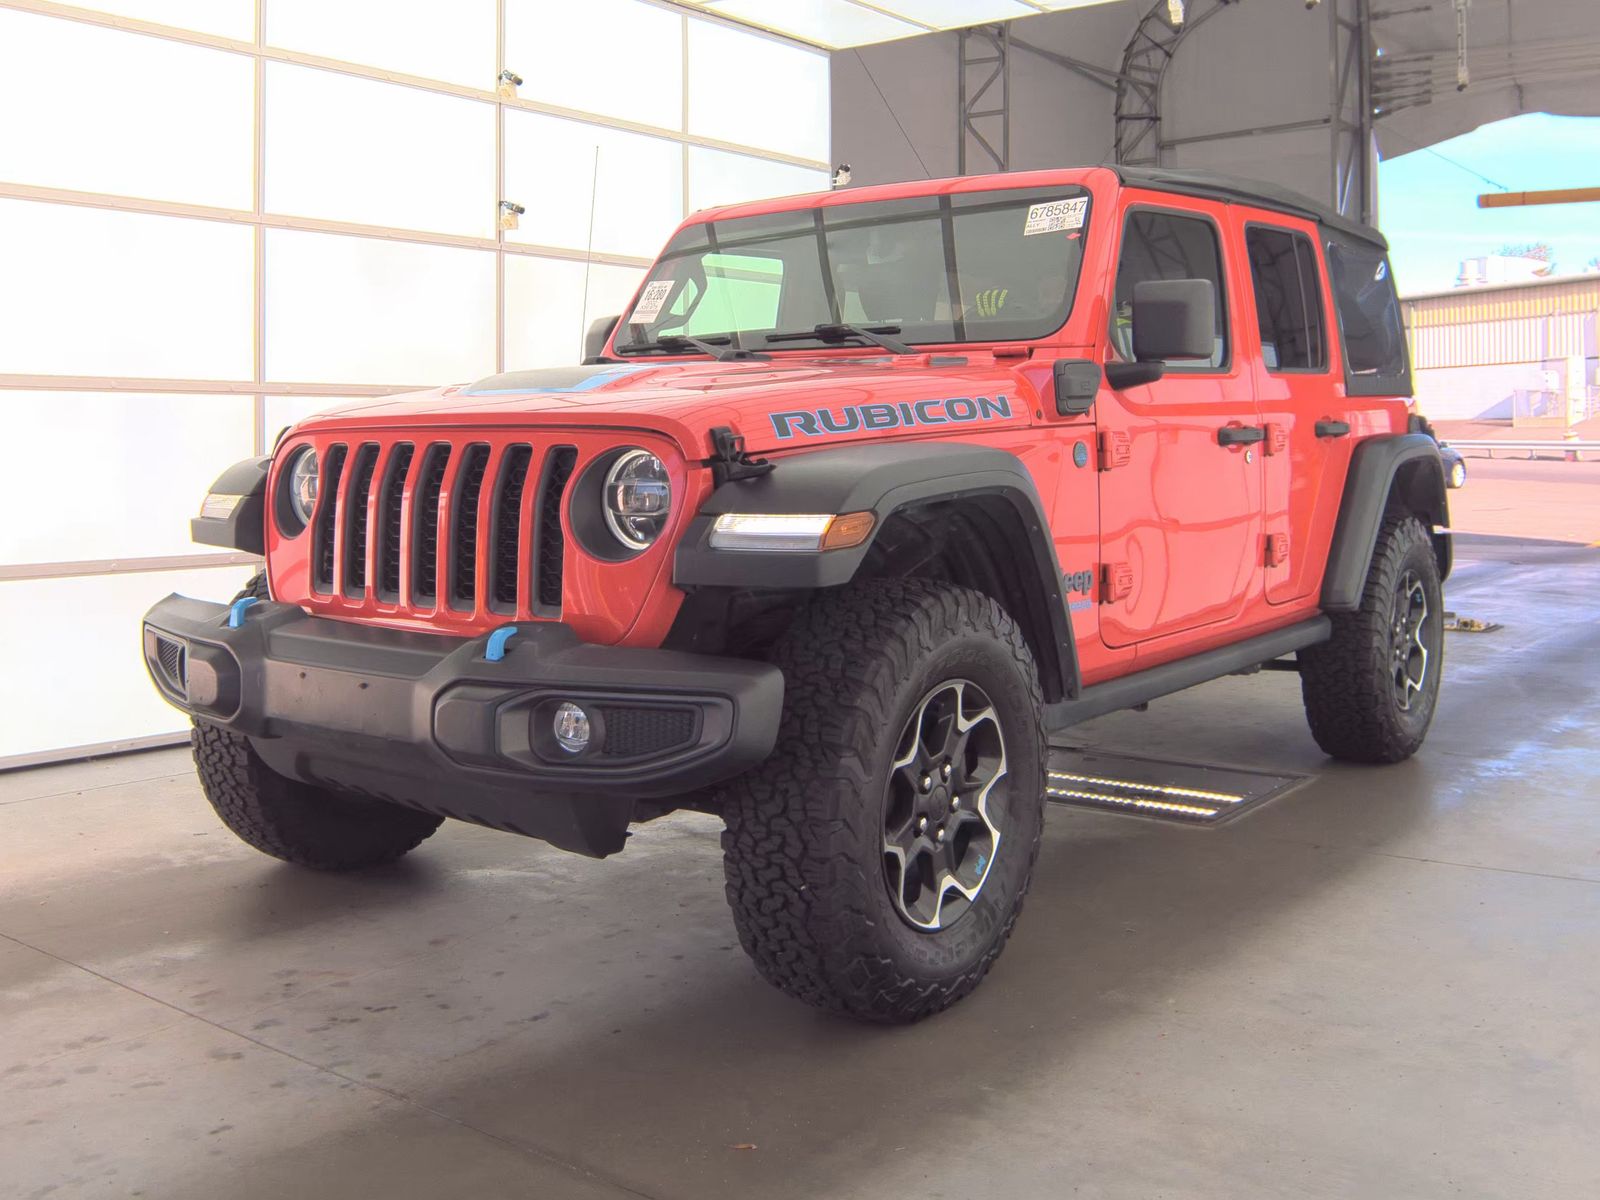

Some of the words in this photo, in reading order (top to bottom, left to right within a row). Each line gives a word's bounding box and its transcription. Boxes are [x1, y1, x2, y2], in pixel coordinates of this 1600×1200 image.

[1030, 201, 1086, 219] 6785847
[770, 396, 1012, 438] RUBICON
[1064, 570, 1094, 596] eep
